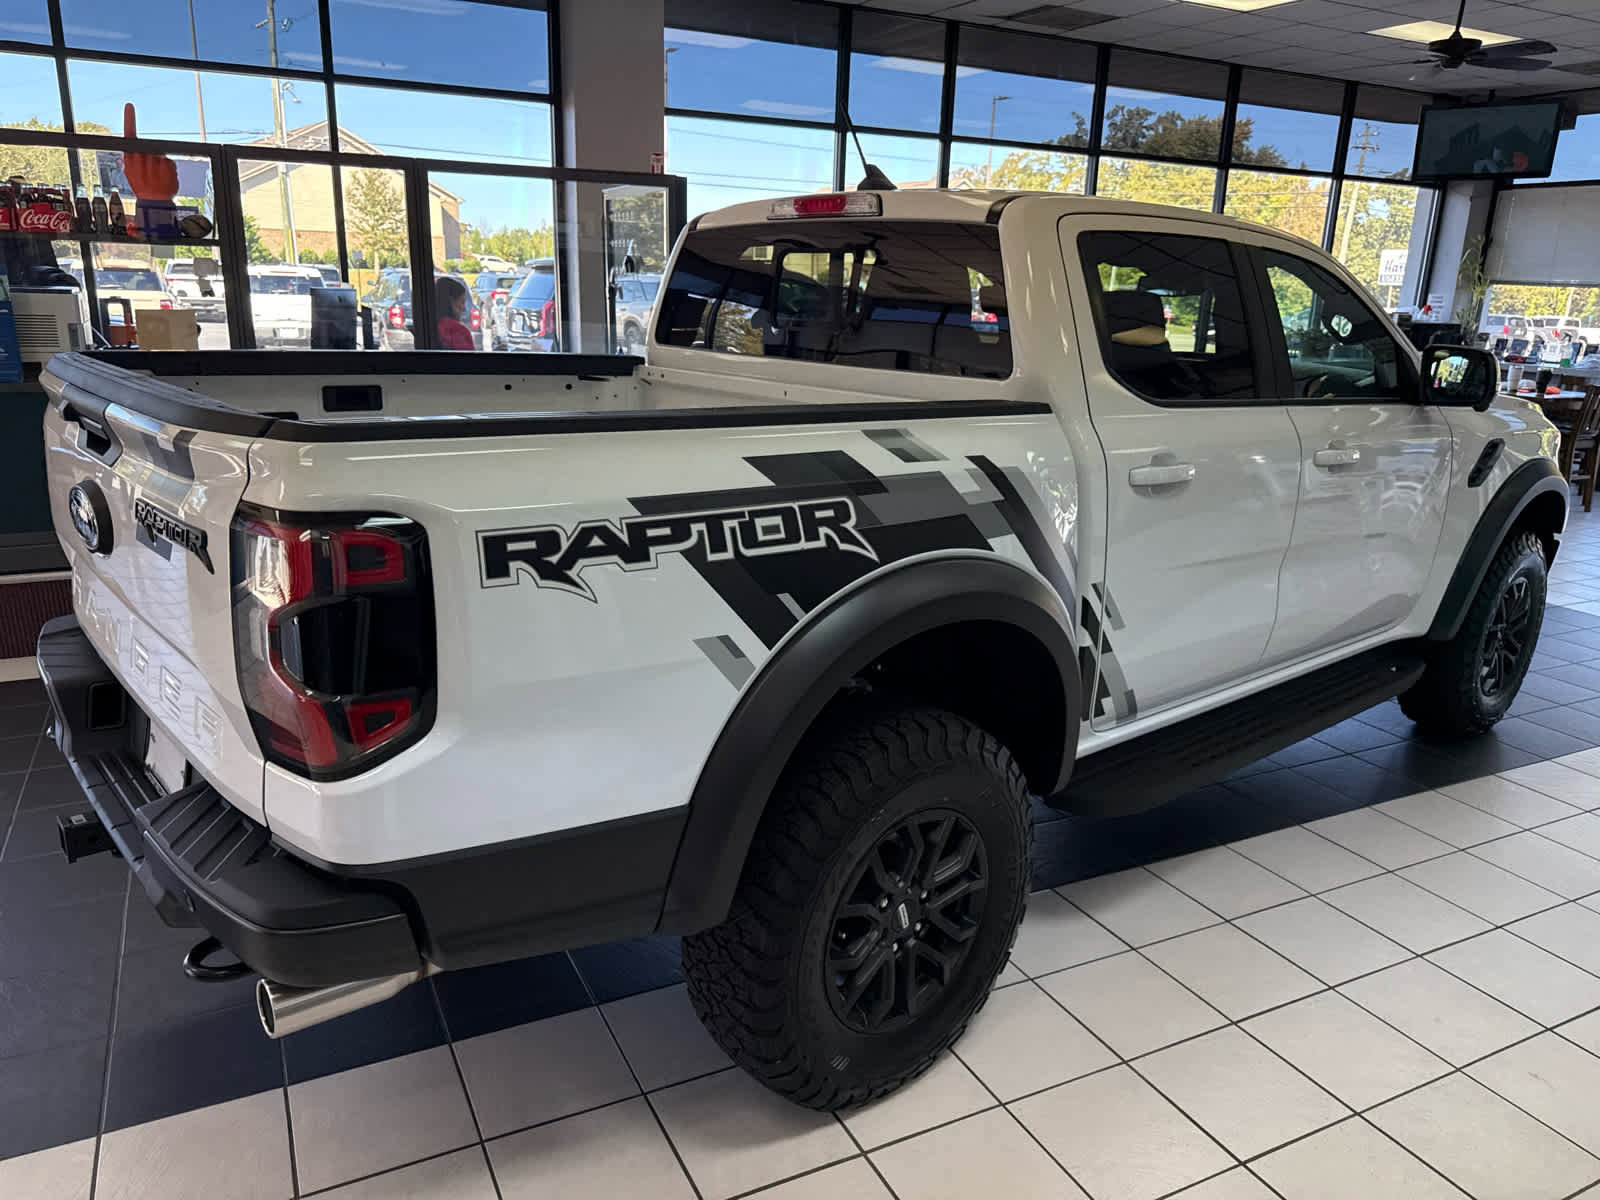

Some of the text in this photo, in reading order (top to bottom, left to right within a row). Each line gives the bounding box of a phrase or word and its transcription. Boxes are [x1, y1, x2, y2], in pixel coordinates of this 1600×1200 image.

[20, 209, 71, 232] Coca-Co
[135, 498, 214, 575] RAPTOR
[476, 497, 879, 603] RAPTOR
